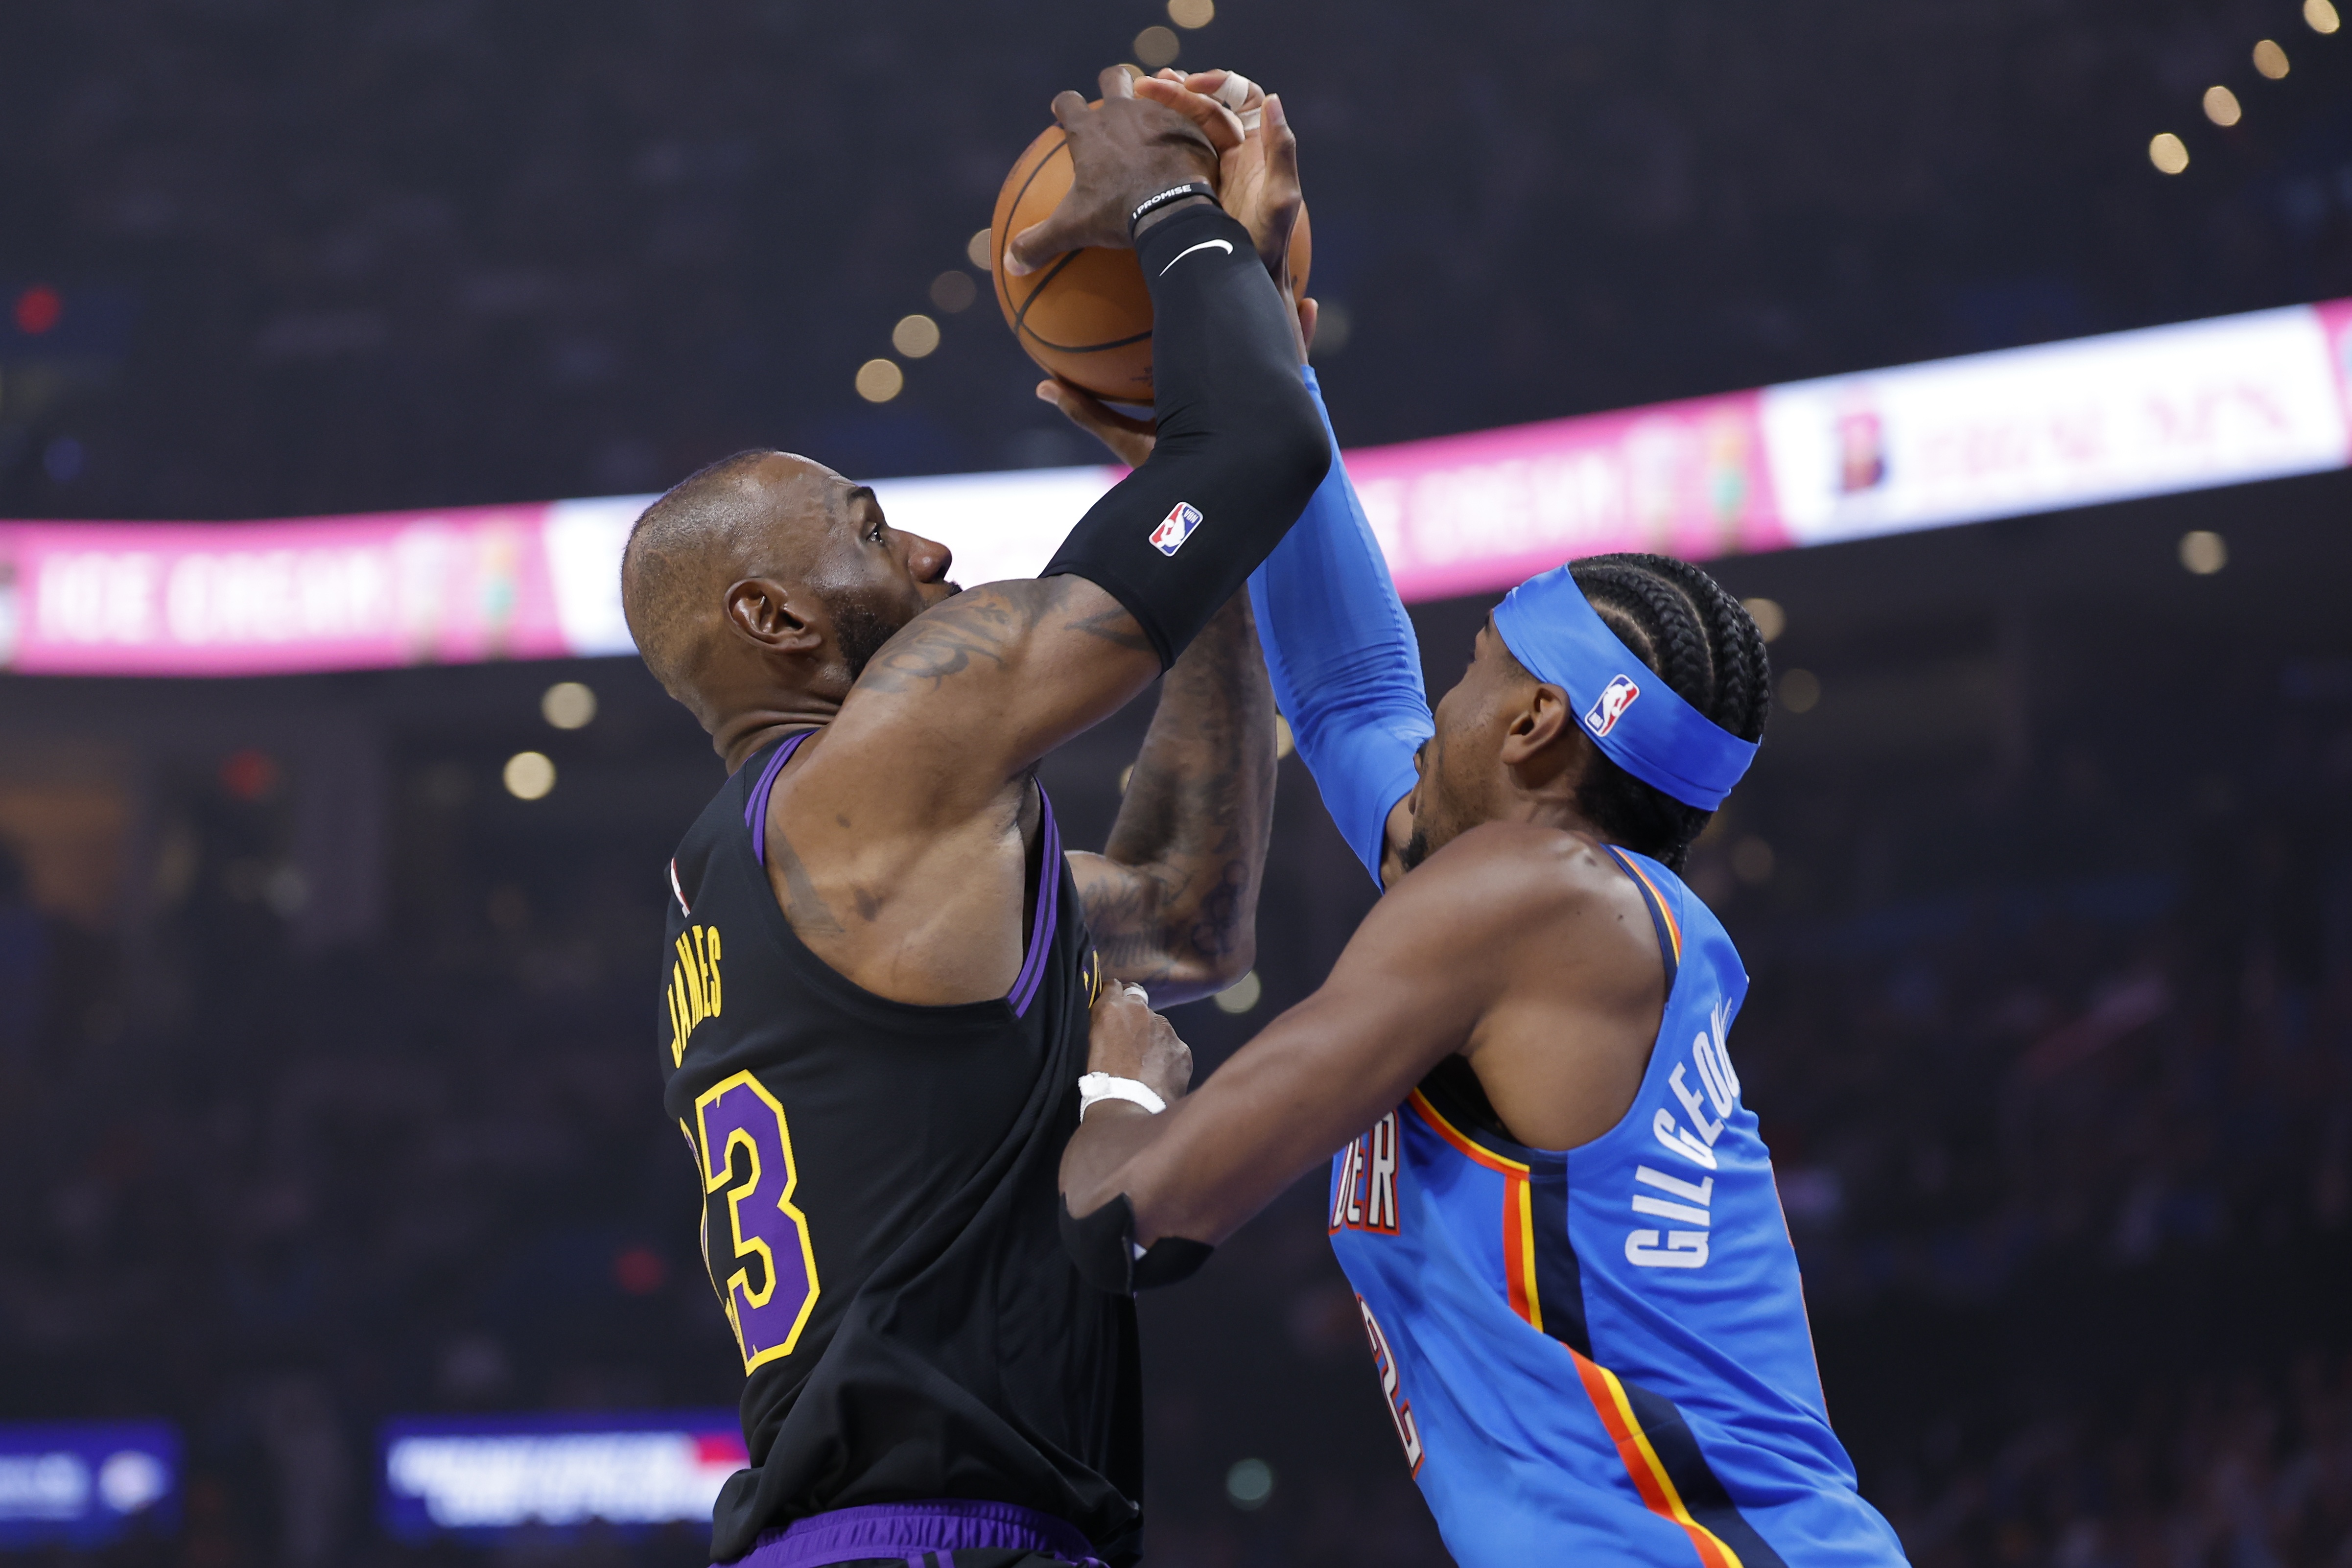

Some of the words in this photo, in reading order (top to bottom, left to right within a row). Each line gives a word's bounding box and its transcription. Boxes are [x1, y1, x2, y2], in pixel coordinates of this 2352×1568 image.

[1132, 211, 1137, 220] I
[1137, 184, 1192, 214] PROMISE
[667, 924, 721, 1069] JAMES
[680, 1068, 821, 1377] 3
